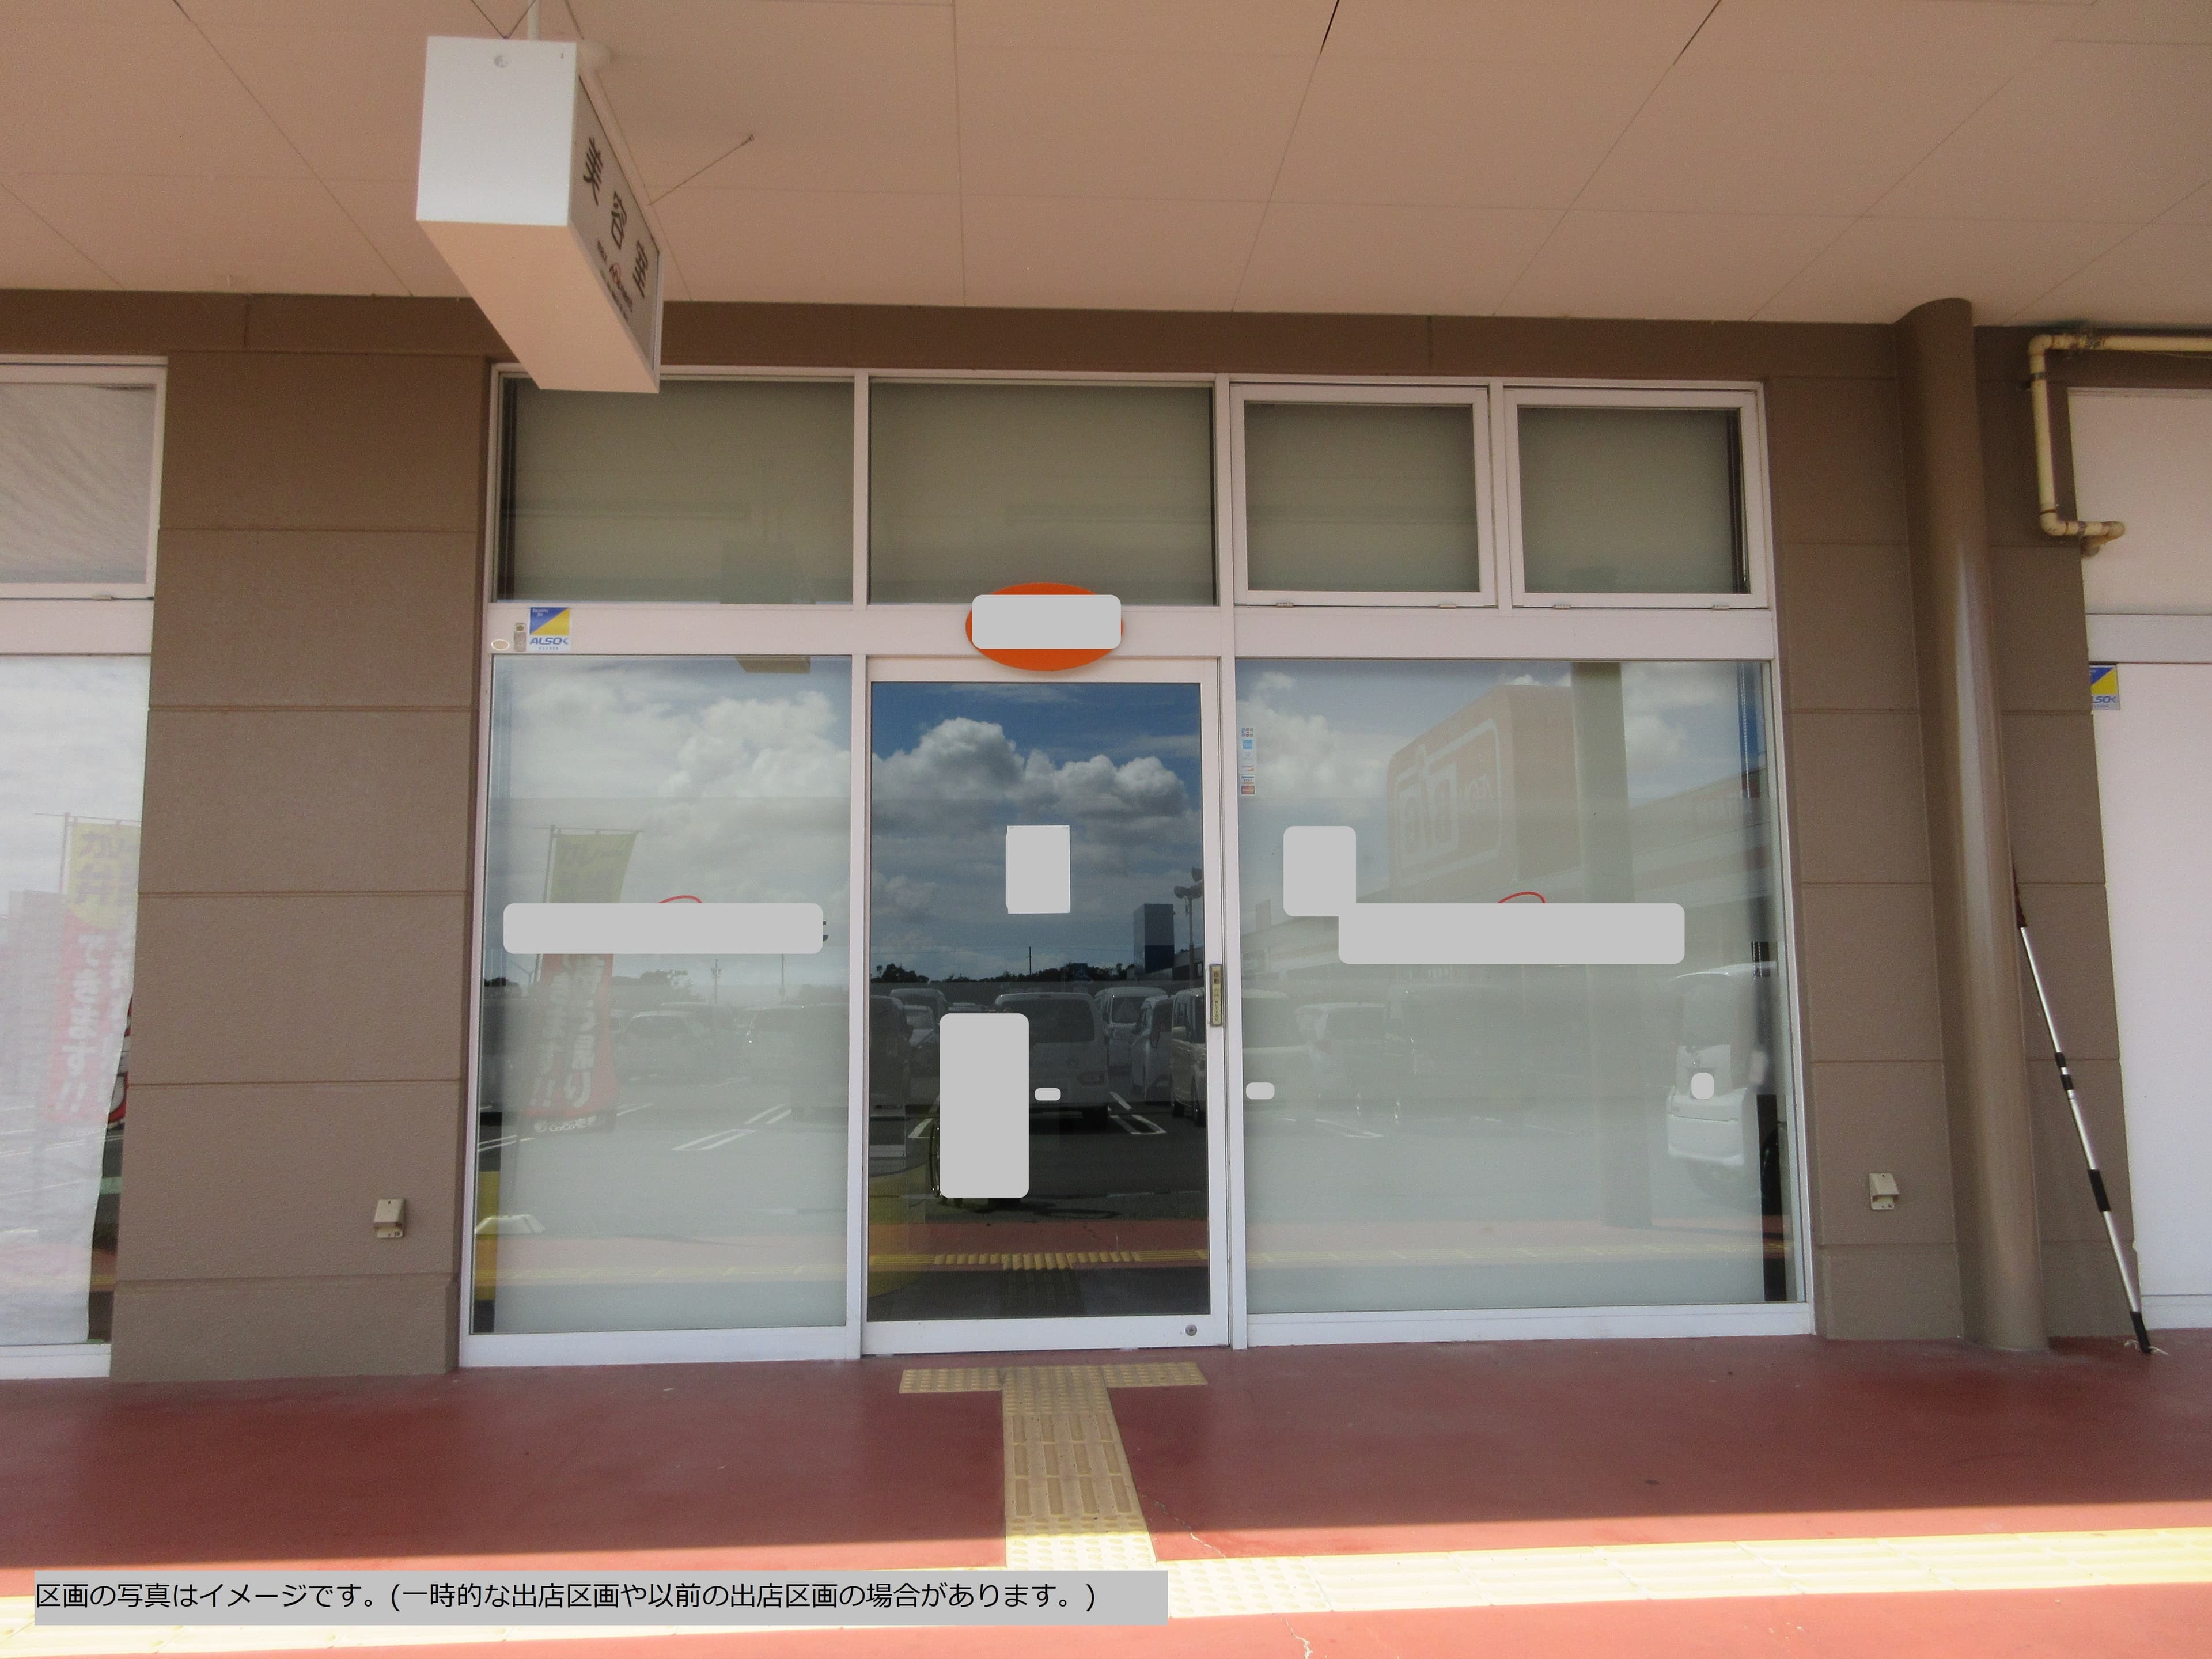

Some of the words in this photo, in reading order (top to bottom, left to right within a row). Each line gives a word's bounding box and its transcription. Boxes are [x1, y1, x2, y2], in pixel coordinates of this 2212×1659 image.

[583, 137, 649, 298] 美容室
[529, 637, 569, 645] ALSOK
[2093, 695, 2117, 703] SOK
